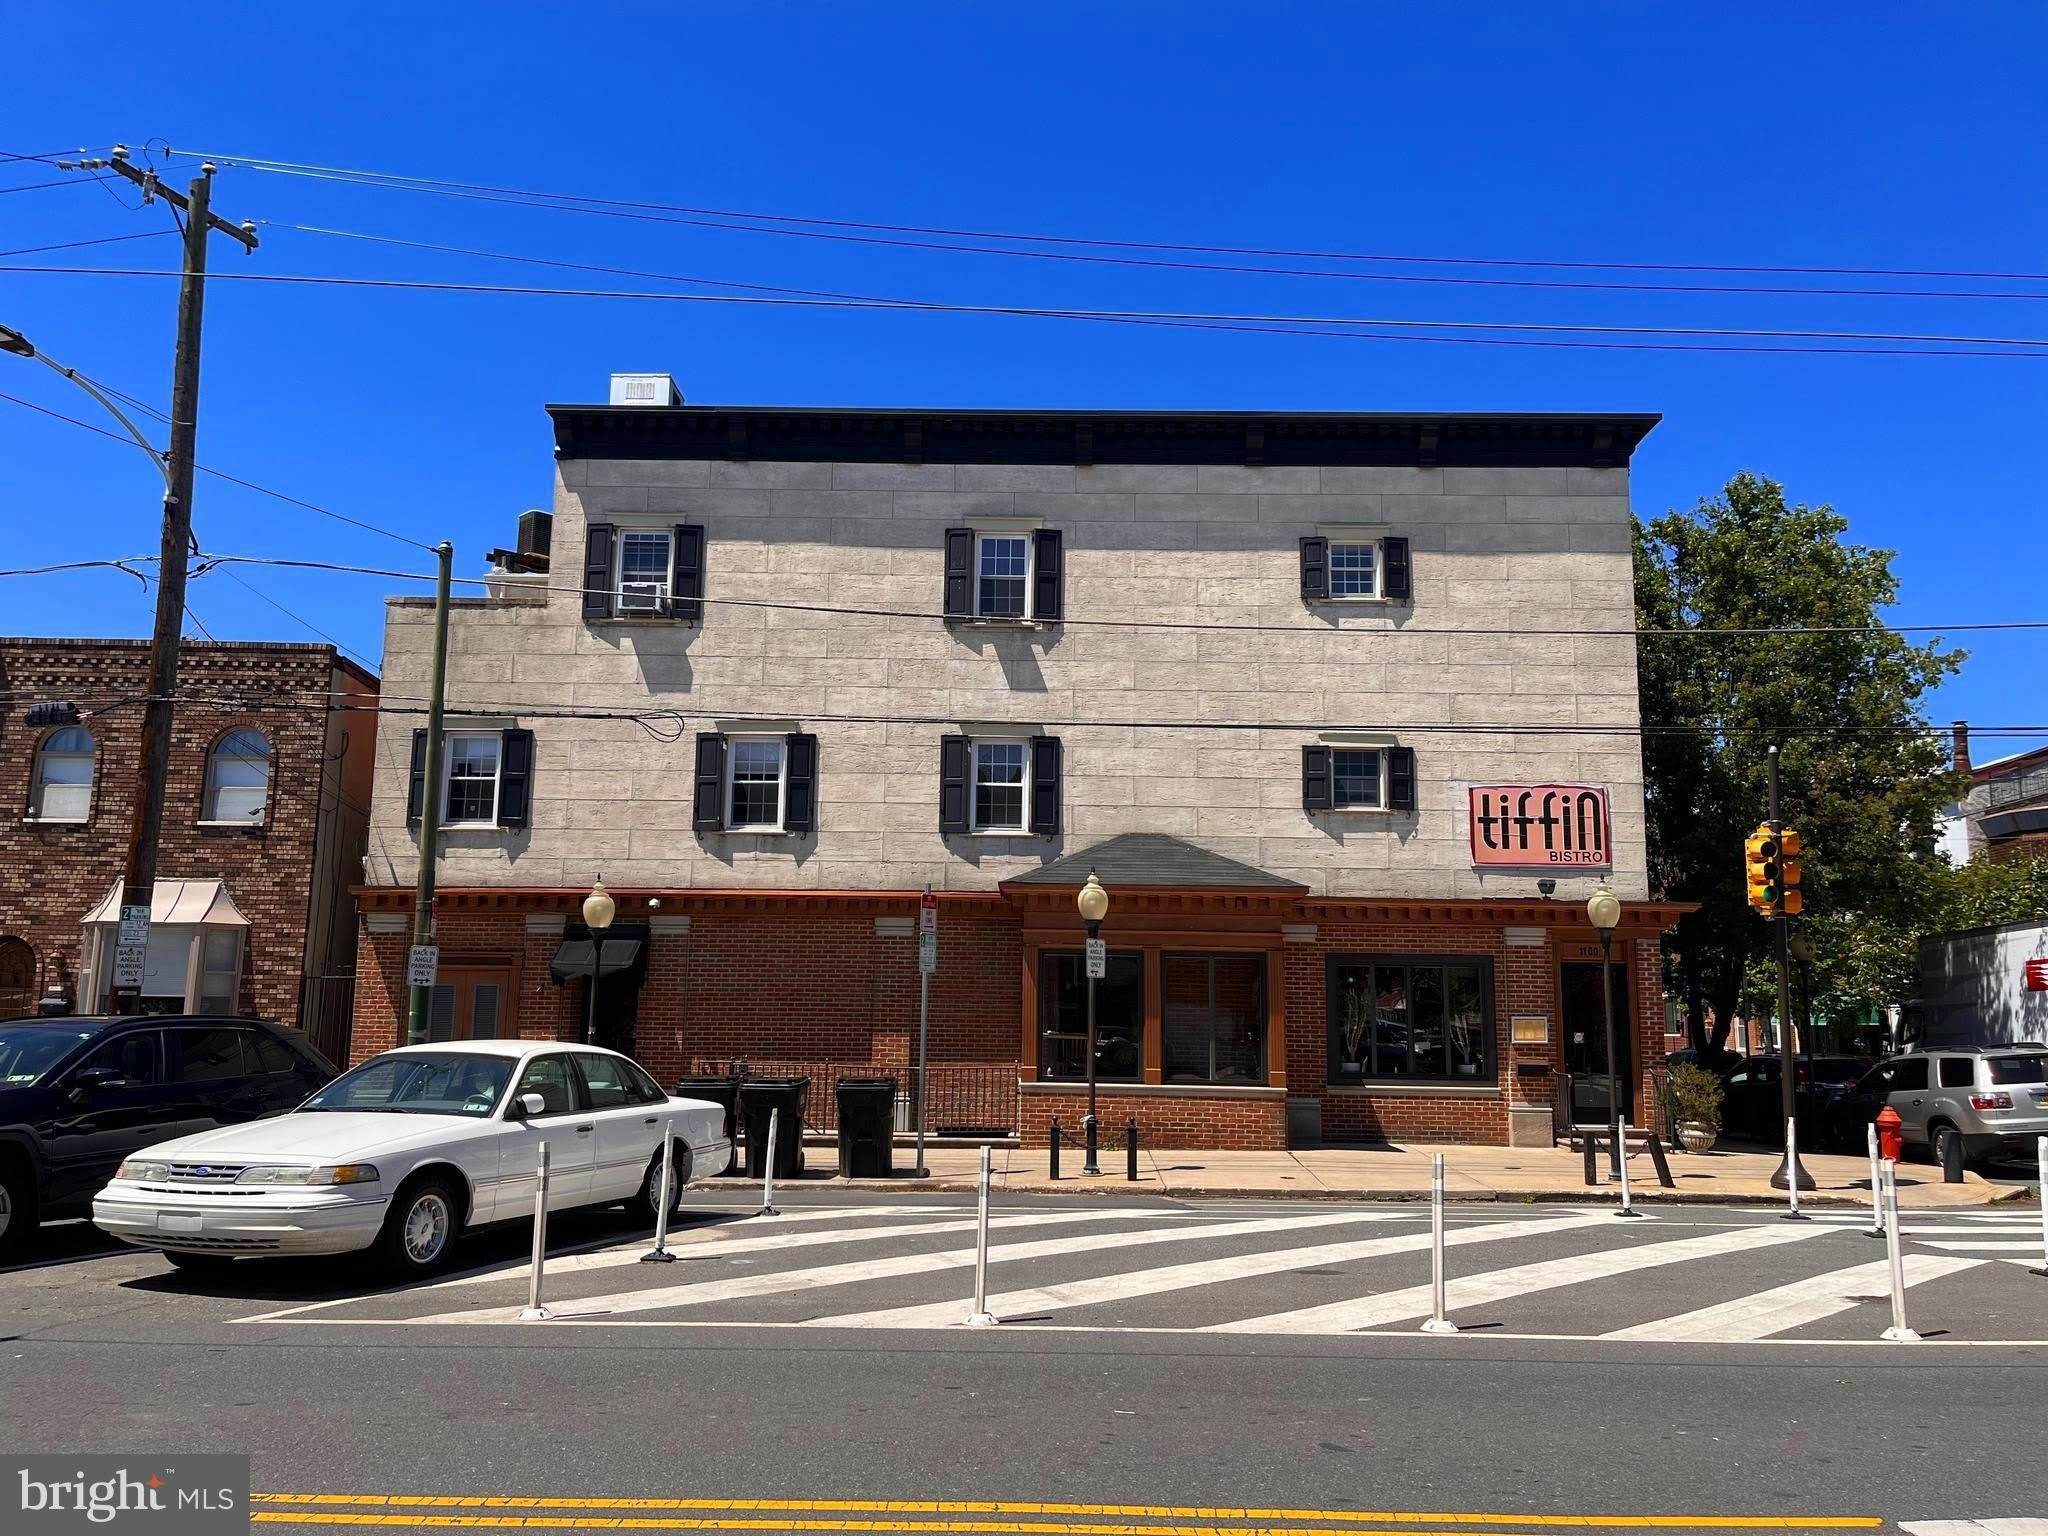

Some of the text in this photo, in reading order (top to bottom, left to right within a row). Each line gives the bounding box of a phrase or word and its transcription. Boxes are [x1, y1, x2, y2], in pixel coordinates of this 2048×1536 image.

[1477, 791, 1602, 850] tiffin
[1549, 851, 1603, 863] BISTRO
[123, 908, 130, 919] 2
